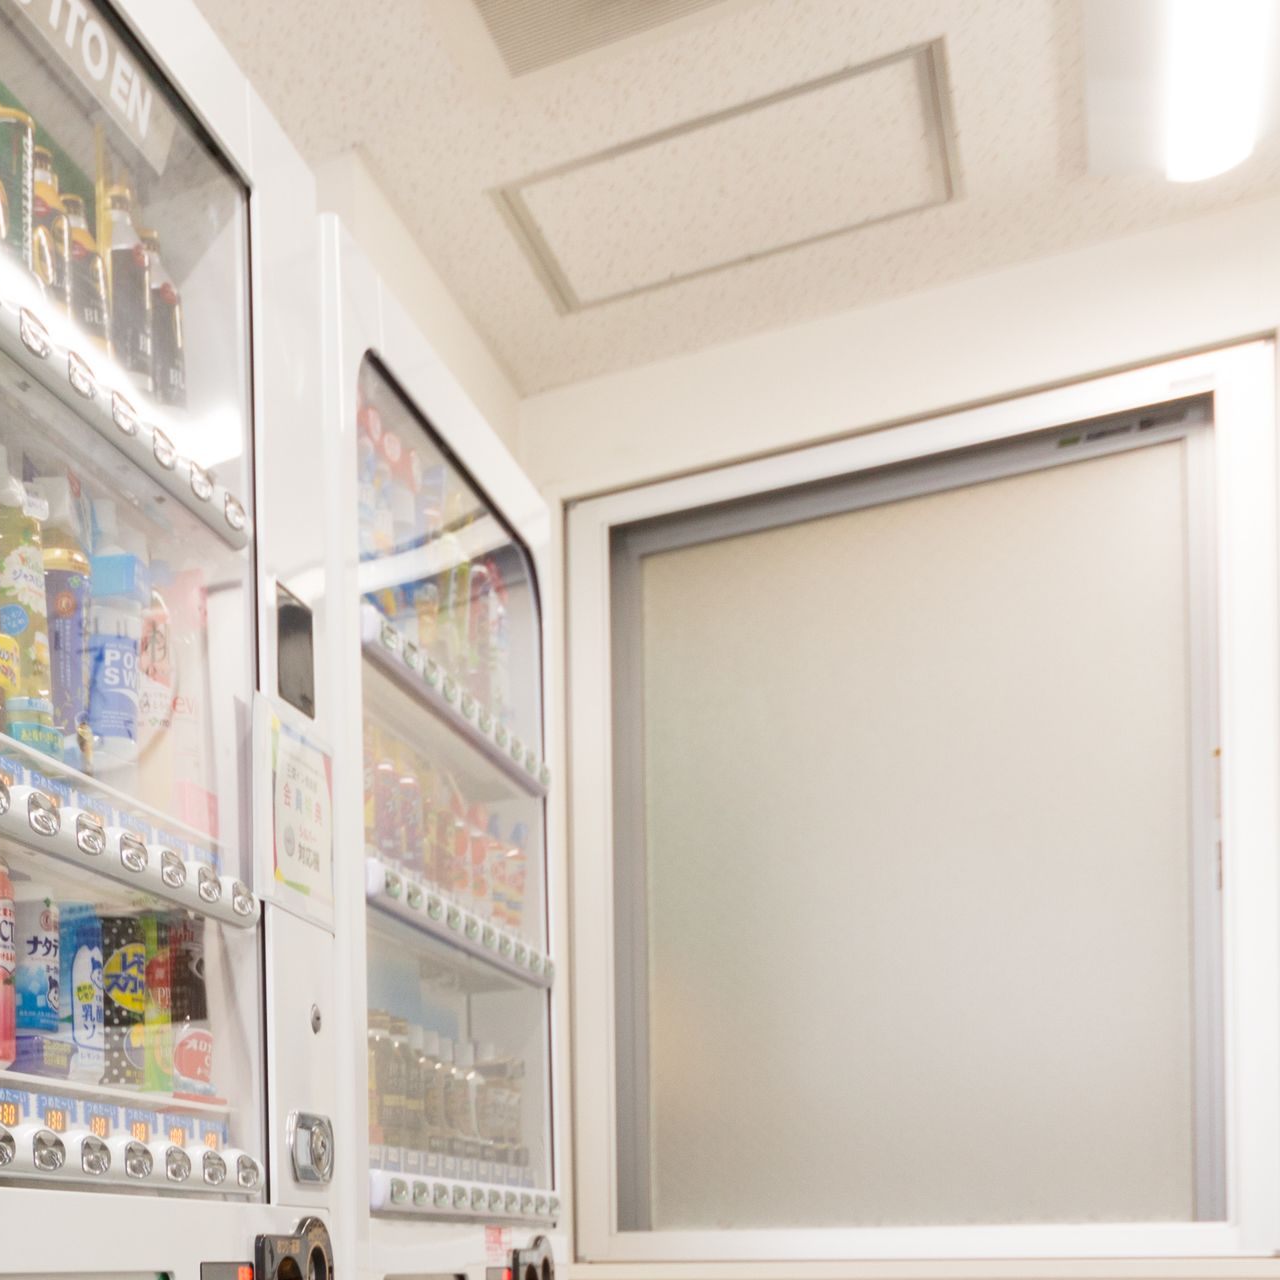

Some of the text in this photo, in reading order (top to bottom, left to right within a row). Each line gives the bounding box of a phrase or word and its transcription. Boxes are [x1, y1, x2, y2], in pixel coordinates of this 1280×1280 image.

[46, 1110, 62, 1130] 130
[91, 1116, 106, 1136] 130
[131, 1122, 145, 1140] 130
